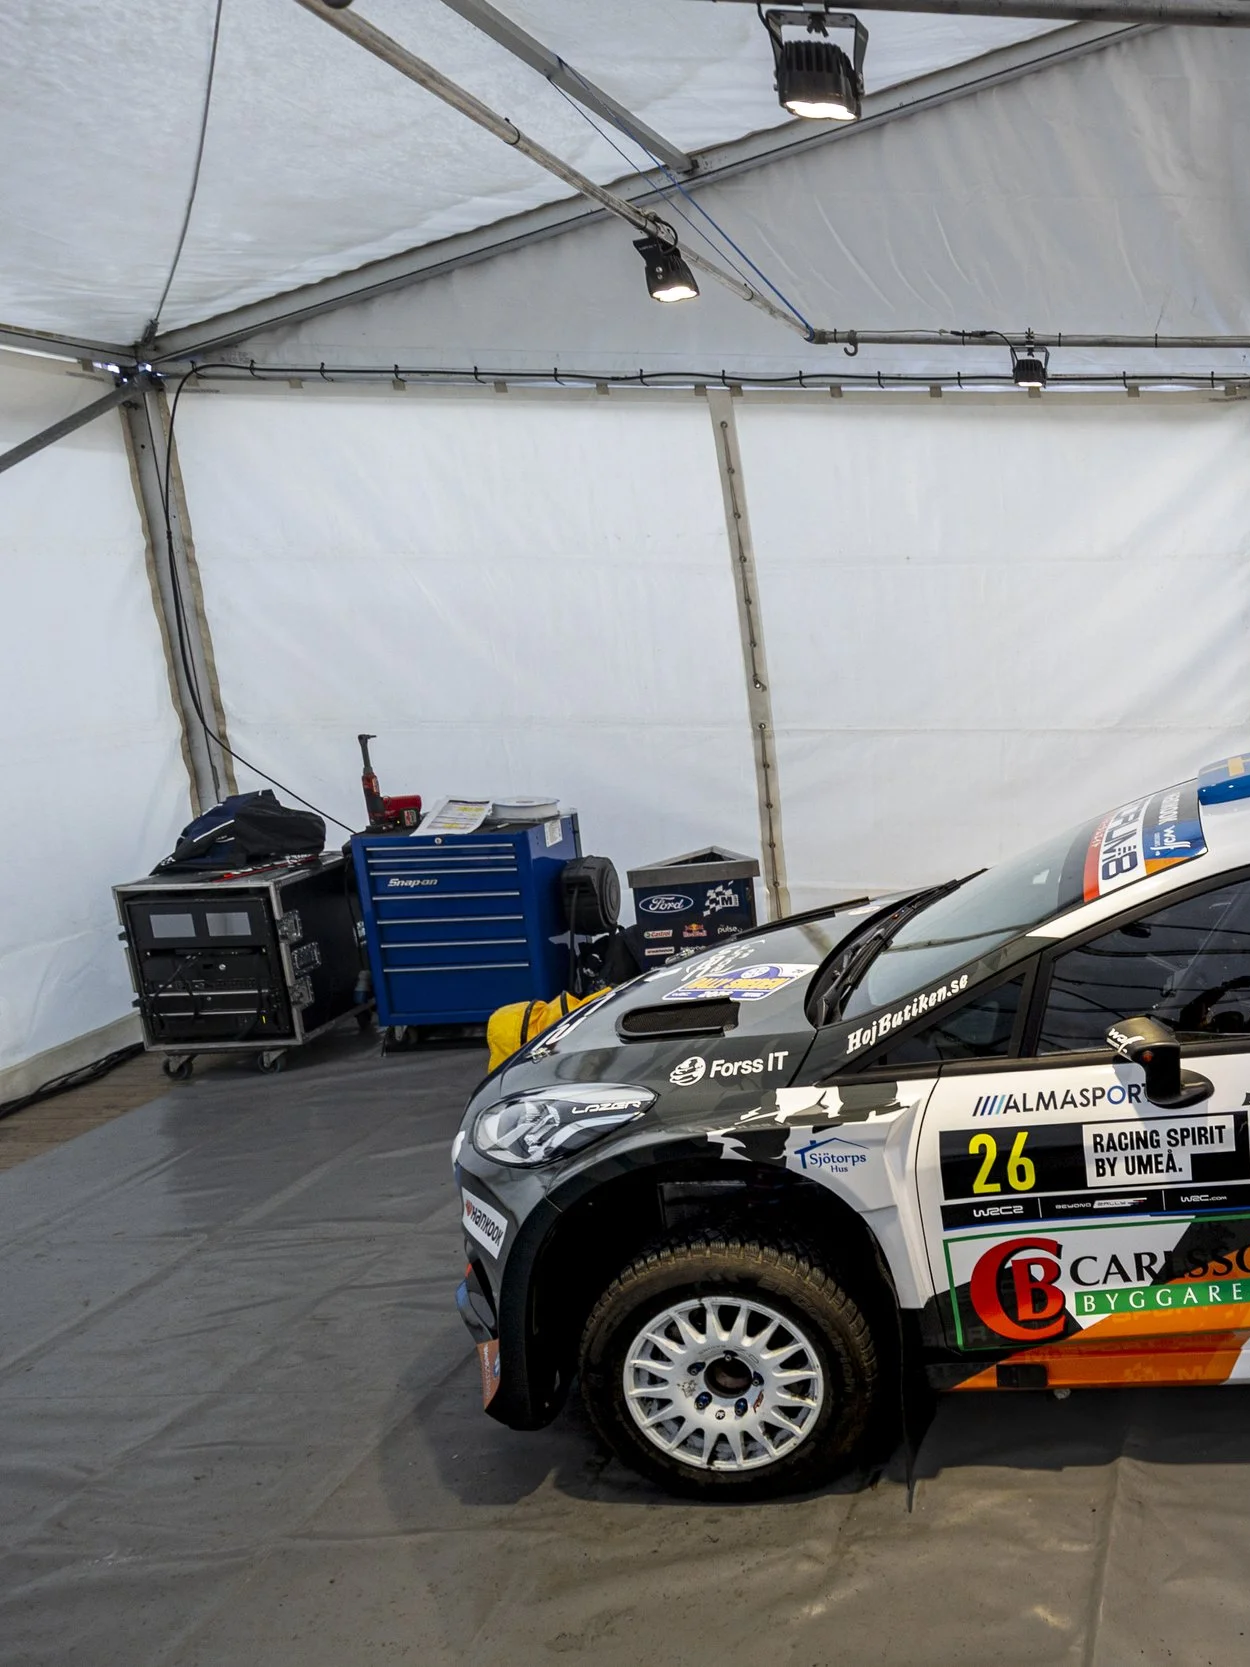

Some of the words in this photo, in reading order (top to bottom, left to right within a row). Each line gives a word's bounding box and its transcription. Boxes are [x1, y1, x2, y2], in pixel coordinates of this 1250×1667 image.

[387, 878, 438, 888] Snap-on
[649, 897, 684, 911] Ford
[709, 1058, 764, 1078] Forss
[767, 1051, 789, 1072] IT
[1003, 1083, 1146, 1115] ALMASPOR
[571, 1101, 642, 1114] LAZER
[1092, 1127, 1161, 1154] RACING
[1166, 1124, 1227, 1147] SPIRIT
[809, 1152, 867, 1168] Sjötorps
[968, 1131, 1037, 1195] 26
[1096, 1155, 1119, 1178] BY
[1124, 1149, 1183, 1177] UMEÅ.
[830, 1165, 849, 1173] Hus
[972, 1204, 1025, 1218] WRC2
[1055, 1202, 1092, 1210] BEYOND
[1083, 1282, 1243, 1313] BYGGARE
